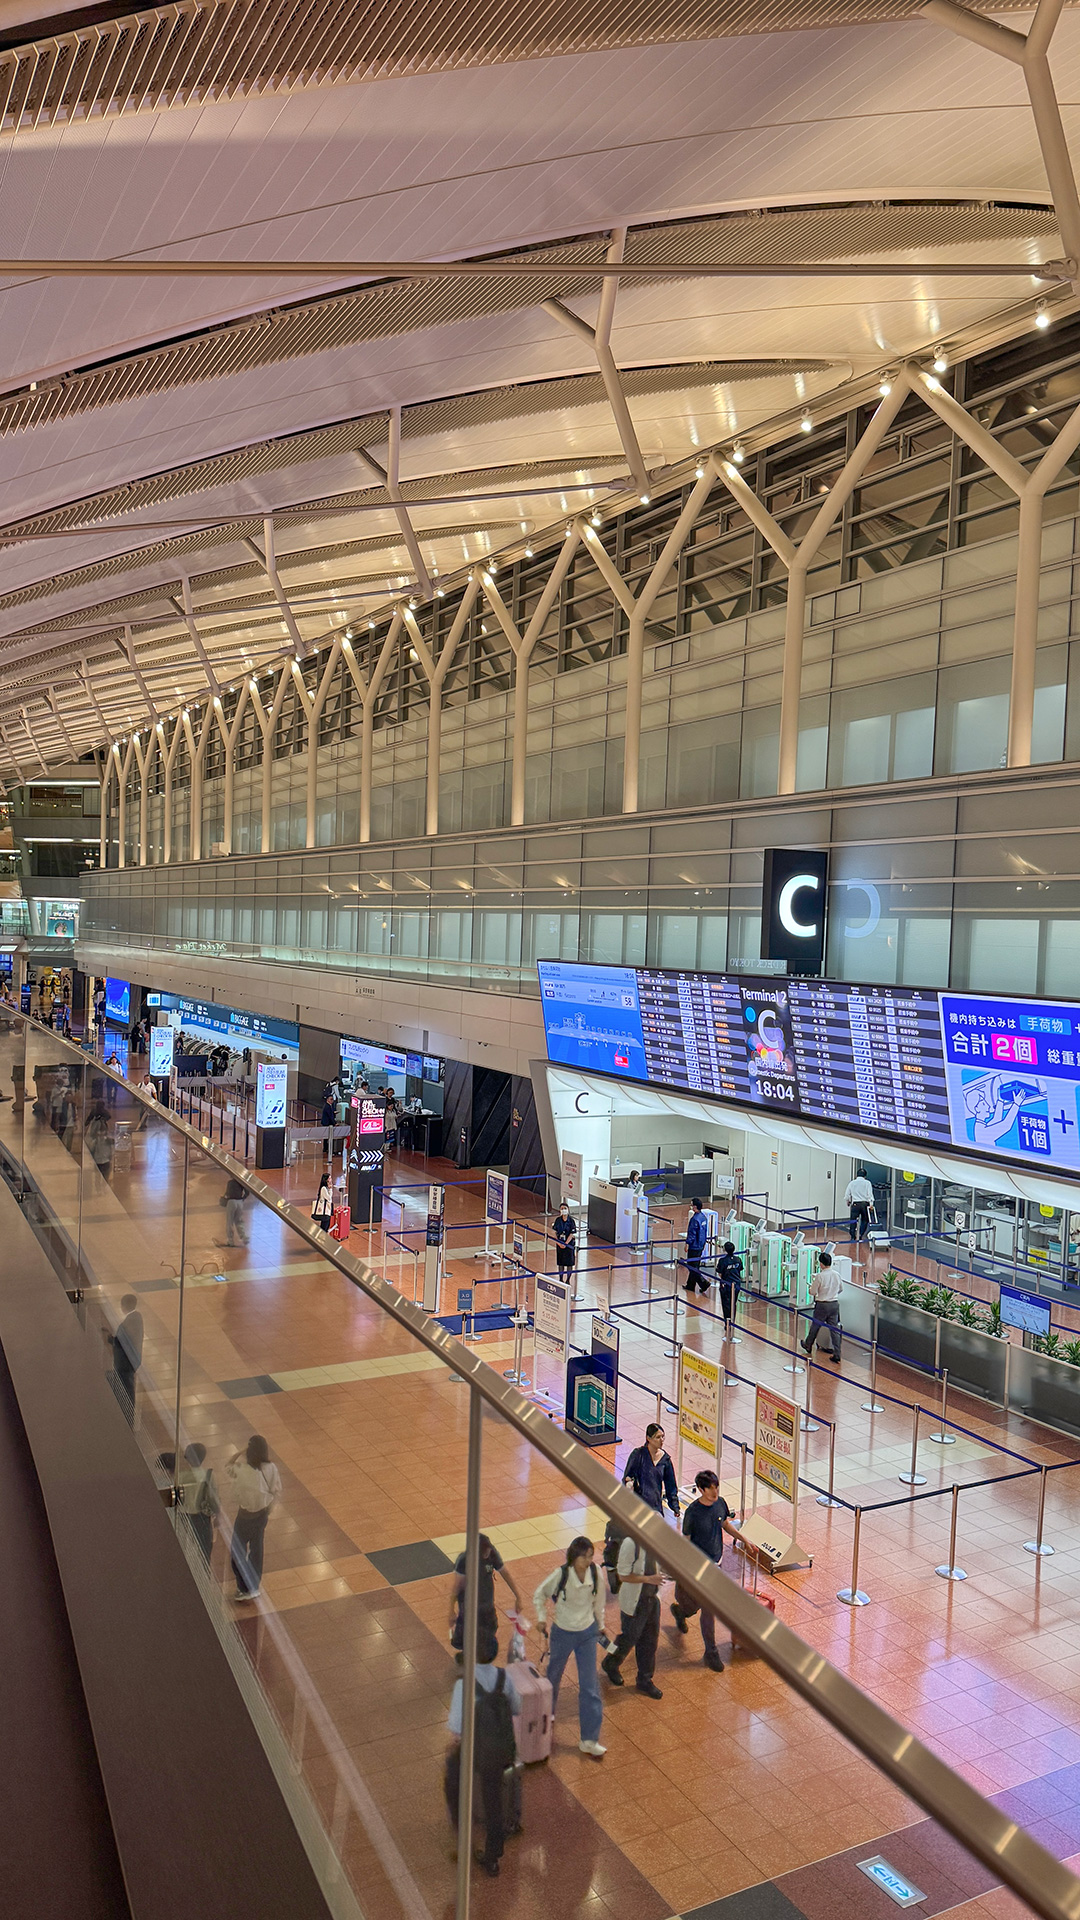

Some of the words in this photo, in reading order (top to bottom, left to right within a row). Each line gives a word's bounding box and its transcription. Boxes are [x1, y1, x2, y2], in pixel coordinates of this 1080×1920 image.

[779, 874, 818, 938] C
[741, 988, 778, 1002] Terminal
[780, 991, 787, 1003] 2
[758, 1010, 778, 1049] C
[950, 1013, 1016, 1029] 機内持ち込みは
[1027, 1017, 1063, 1033] 手荷物
[952, 1032, 989, 1056] 合計
[996, 1037, 1032, 1062] 2個
[756, 1080, 794, 1101] 18:04
[575, 1092, 589, 1113] C
[1021, 1116, 1046, 1130] 手荷物
[1022, 1128, 1047, 1150] 1個
